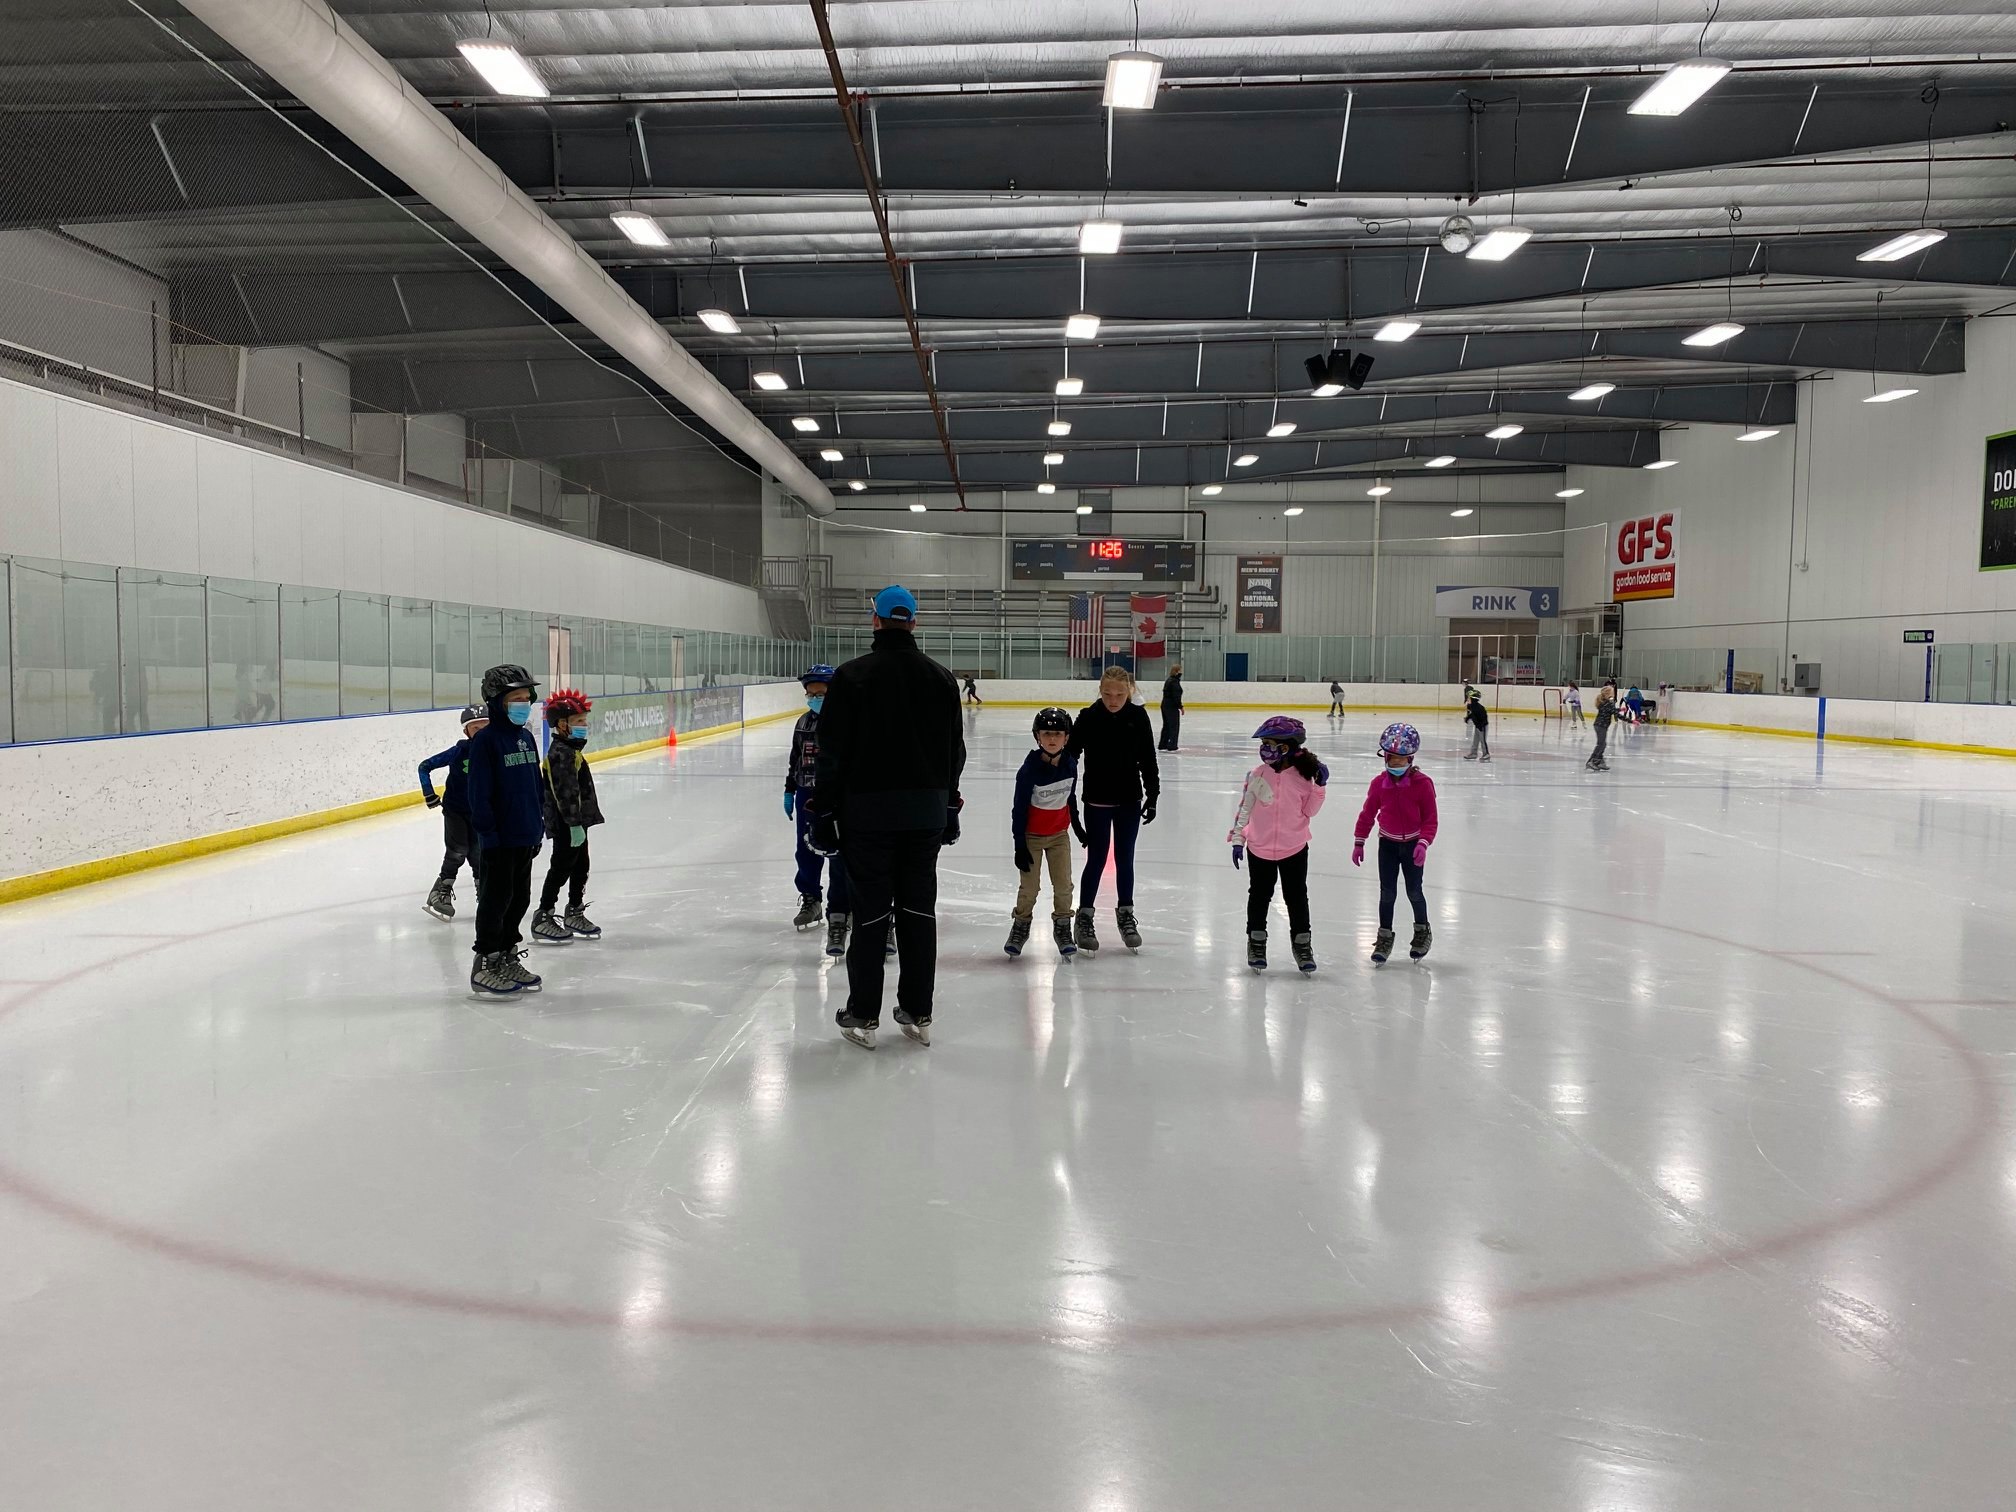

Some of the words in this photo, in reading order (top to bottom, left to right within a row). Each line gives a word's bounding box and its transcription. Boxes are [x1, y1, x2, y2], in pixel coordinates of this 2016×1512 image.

[1090, 541, 1123, 558] 11:26
[1618, 513, 1674, 565] GFS
[1616, 572, 1637, 592] gordon
[1636, 569, 1651, 585] food
[1650, 568, 1672, 584] service
[1472, 595, 1517, 610] RINK
[1540, 593, 1550, 611] 3
[604, 707, 633, 732] SPORTS
[634, 705, 665, 728] INJURIES
